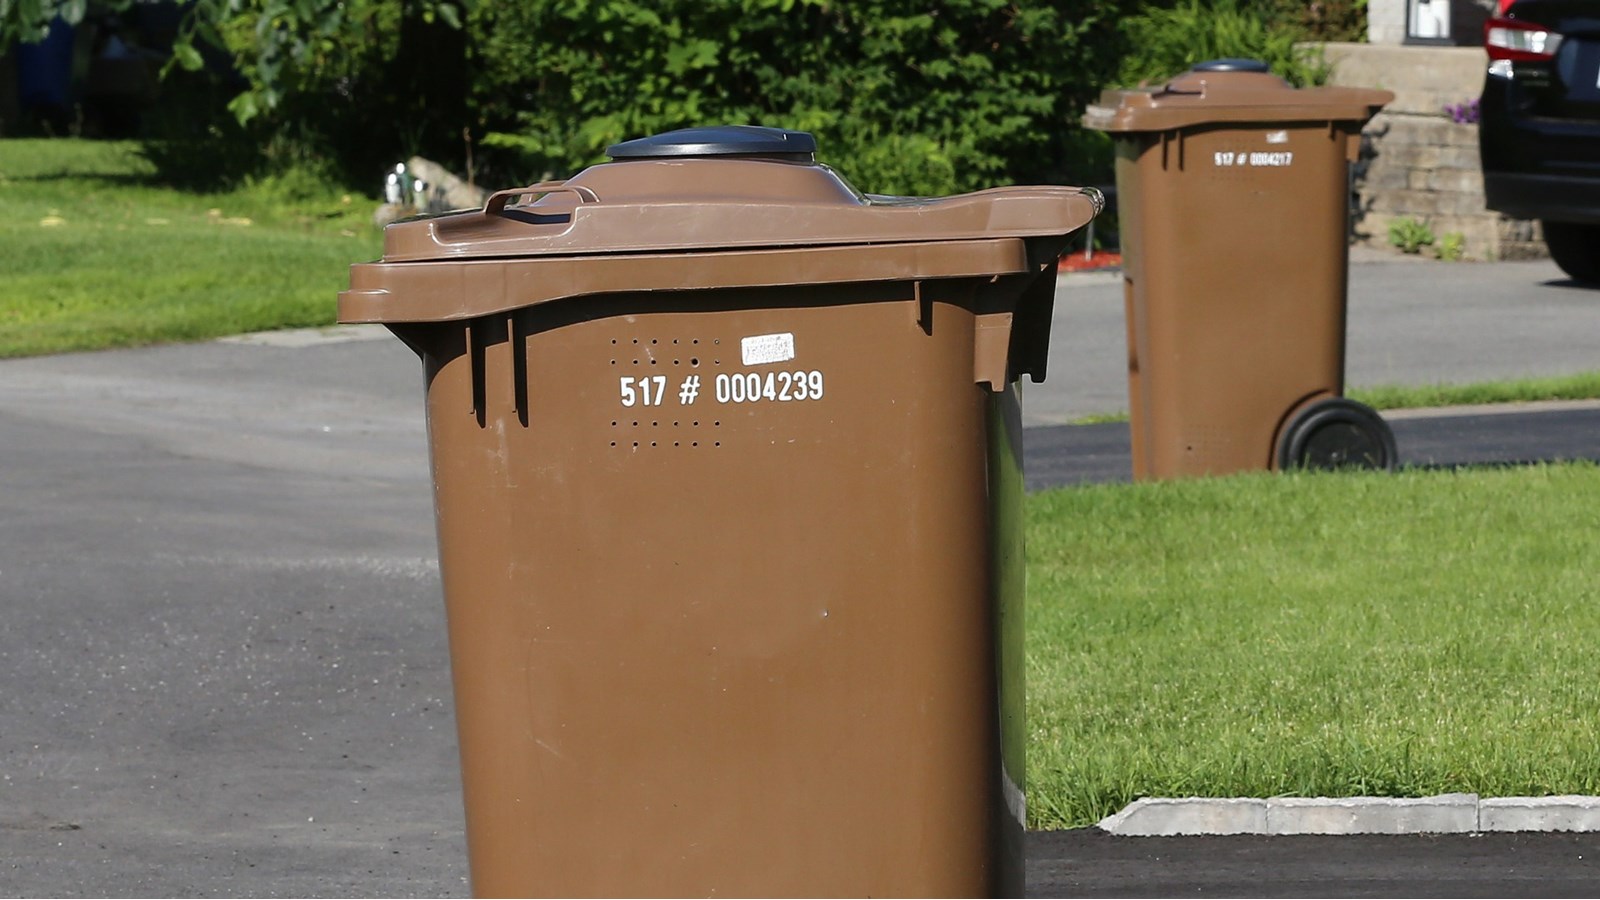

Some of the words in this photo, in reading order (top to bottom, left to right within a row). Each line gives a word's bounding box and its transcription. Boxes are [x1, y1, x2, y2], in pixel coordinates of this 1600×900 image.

[1214, 151, 1234, 166] 517
[1249, 151, 1293, 166] 0004217
[619, 375, 667, 407] 517
[678, 375, 701, 405] #
[715, 370, 823, 403] 0004239
